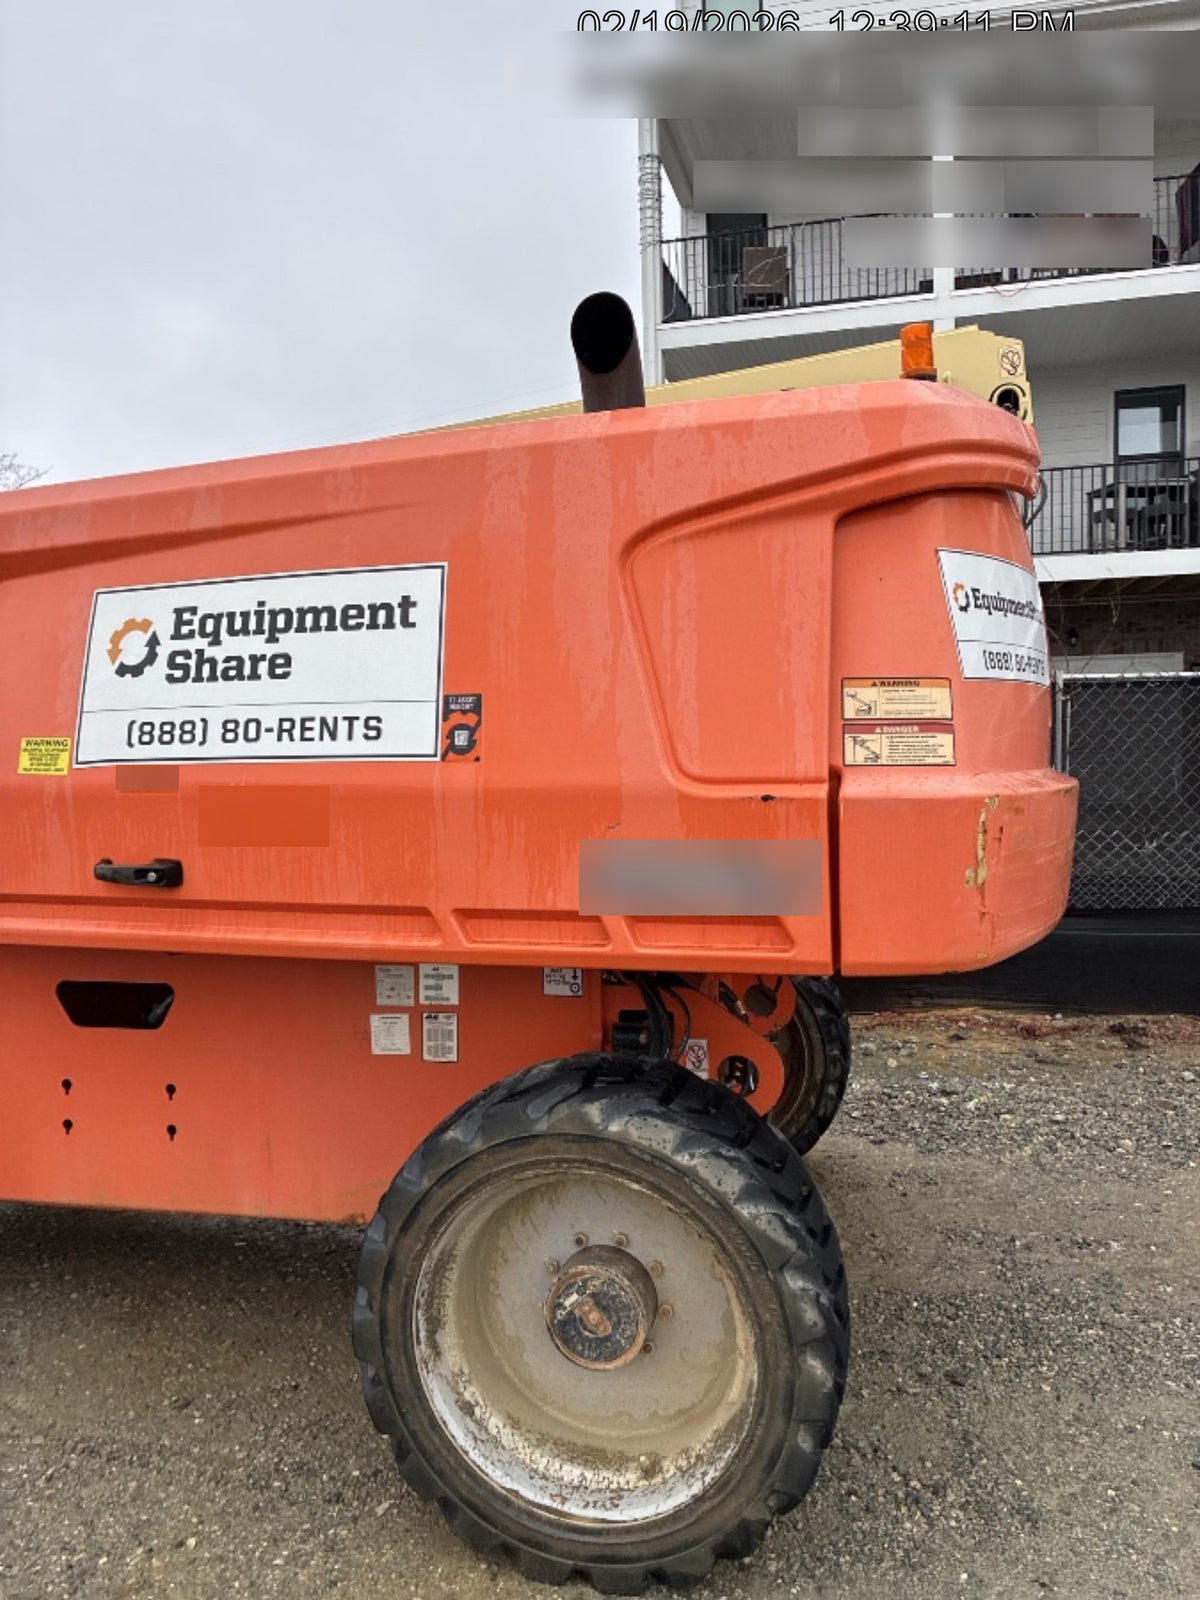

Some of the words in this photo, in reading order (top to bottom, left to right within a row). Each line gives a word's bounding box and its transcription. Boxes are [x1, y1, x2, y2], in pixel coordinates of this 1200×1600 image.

[170, 595, 418, 647] Equipment
[165, 649, 293, 685] Share
[25, 739, 69, 748] WARNING
[126, 718, 209, 748] (888)
[221, 716, 383, 745] 80-RENTS
[882, 725, 919, 734] DANGER
